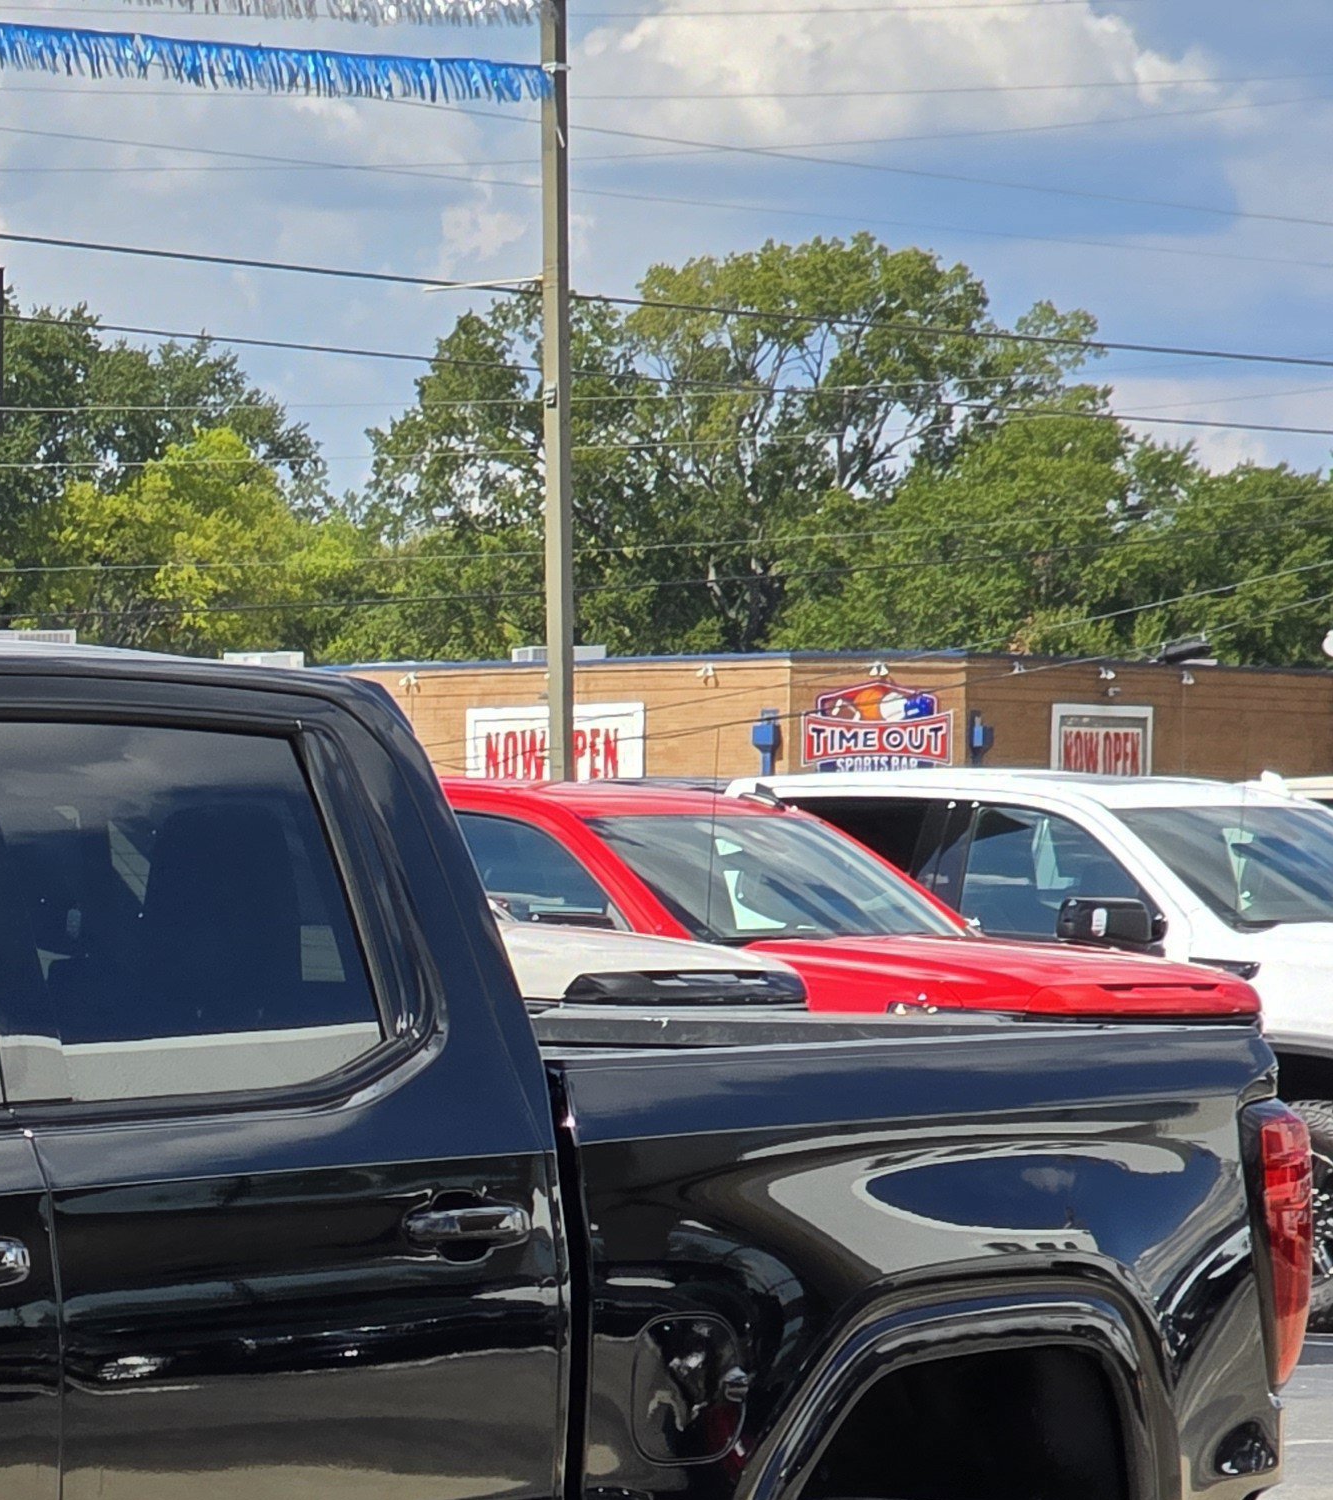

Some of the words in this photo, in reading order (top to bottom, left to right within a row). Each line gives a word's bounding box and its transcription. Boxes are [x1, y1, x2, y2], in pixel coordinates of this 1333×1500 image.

[485, 730, 547, 780] NOW
[573, 727, 620, 779] PEN
[810, 725, 878, 755] TIME
[884, 723, 945, 754] OUT
